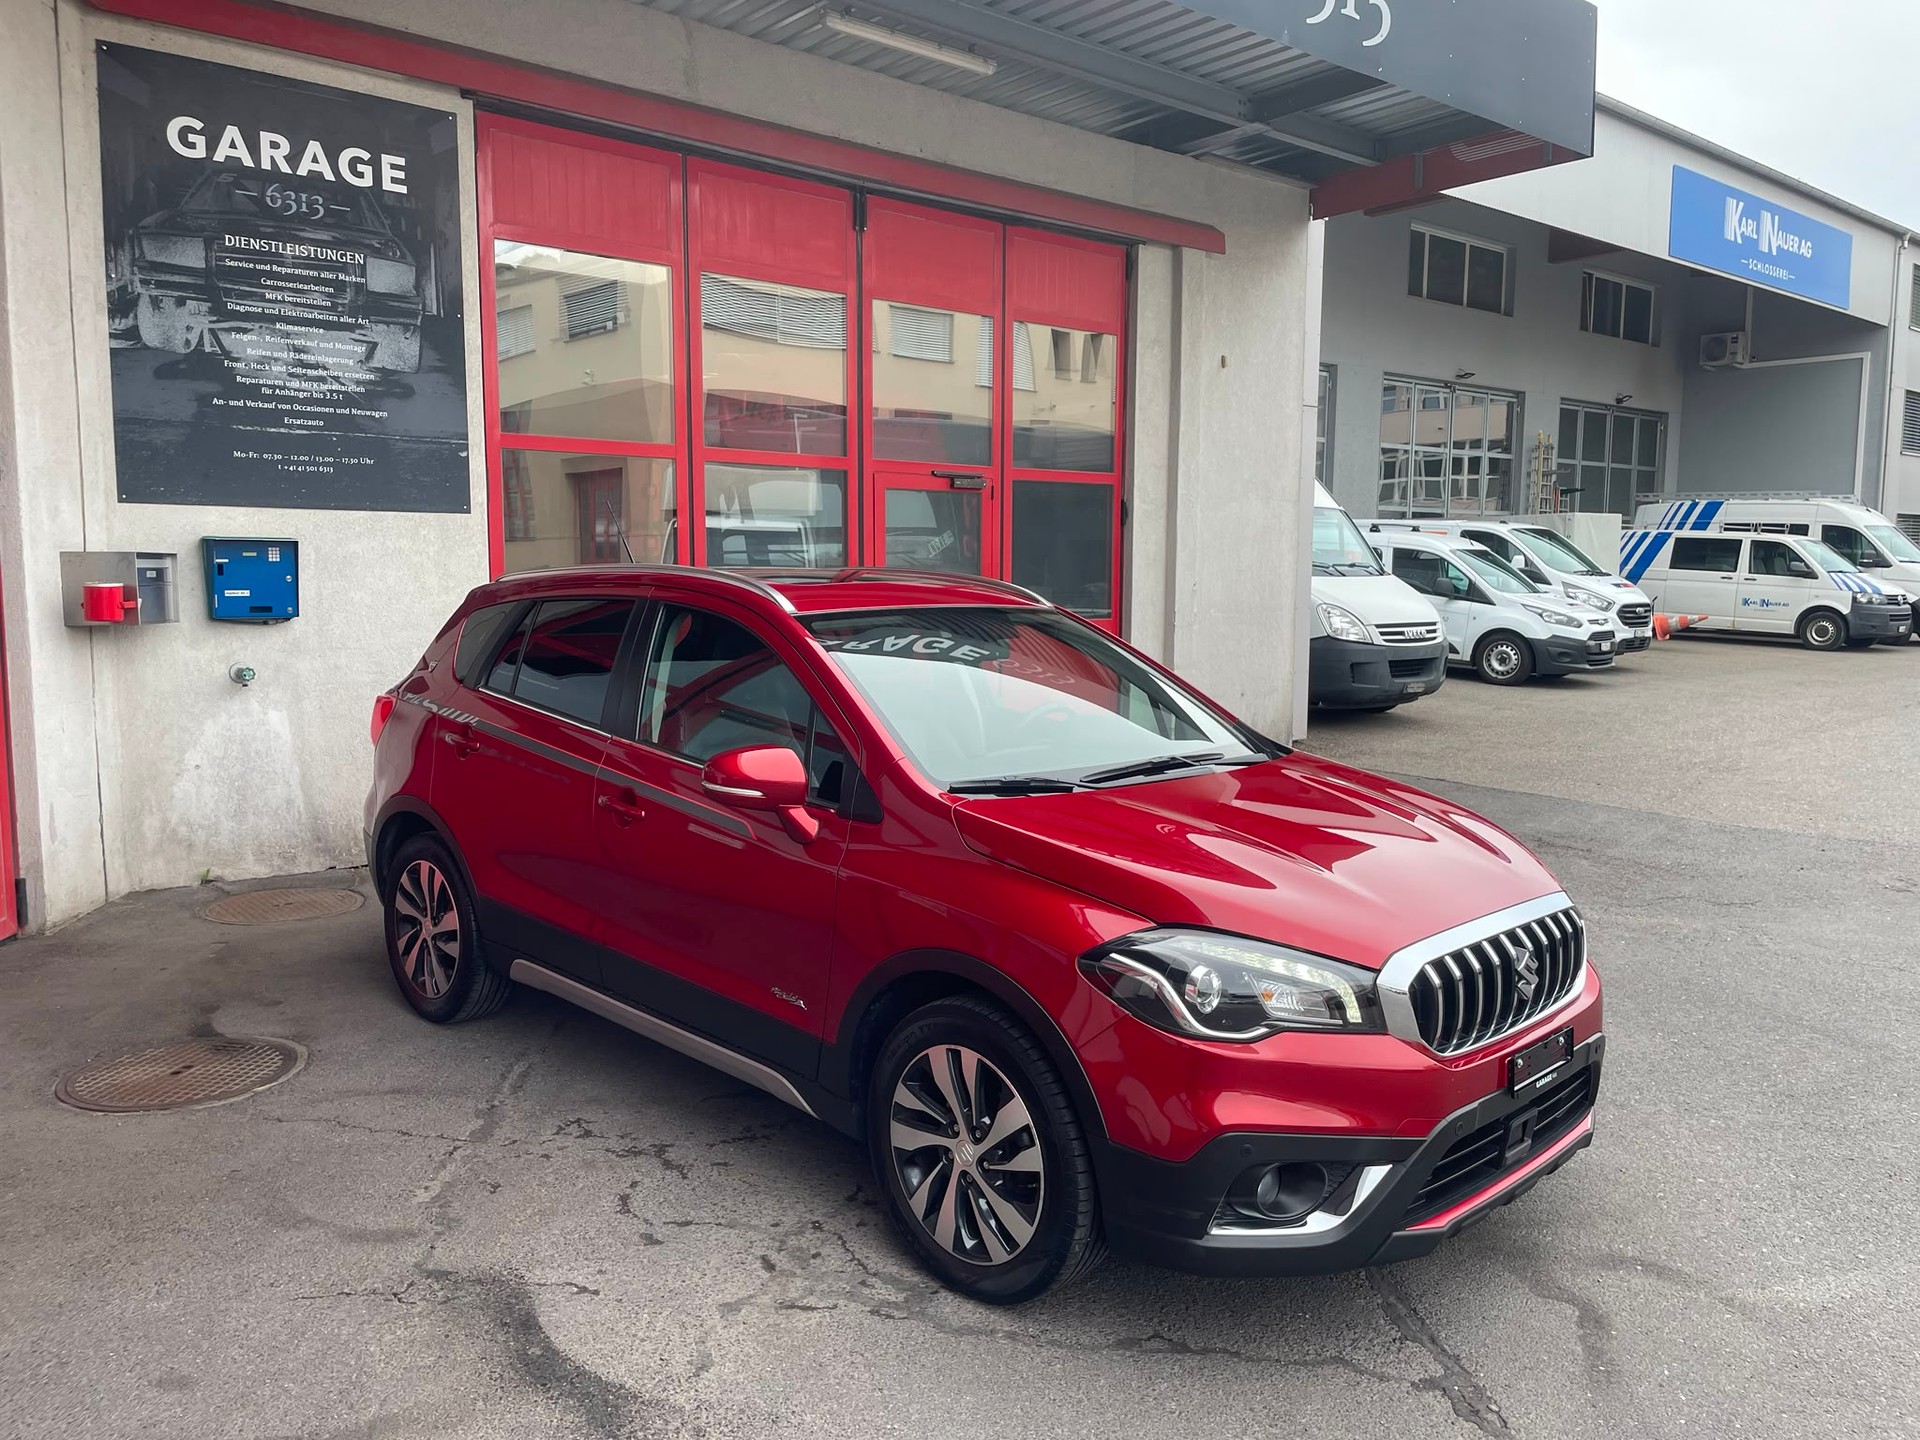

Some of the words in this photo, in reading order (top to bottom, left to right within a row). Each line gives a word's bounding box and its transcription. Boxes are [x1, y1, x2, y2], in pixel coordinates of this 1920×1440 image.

[166, 116, 407, 194] GARAGE
[265, 183, 325, 220] 6313
[1724, 196, 1758, 244] KARL
[1759, 209, 1800, 256] NAUER
[1799, 239, 1812, 259] AG
[225, 235, 364, 264] DIENSTLEISTUNGEN
[225, 259, 254, 269] Service
[256, 263, 270, 271] und
[272, 265, 318, 278] Reparaturen
[320, 271, 336, 280] aller
[338, 273, 365, 283] Marken
[1749, 258, 1789, 280] SCHLOSSEREI
[261, 278, 334, 293] Carrosseriearbeiten
[265, 292, 283, 301] MFK
[284, 294, 331, 307] bereitstellen
[227, 303, 262, 313] Diagnose
[264, 307, 278, 315] und
[281, 308, 338, 322] Elektroarbeiten
[340, 315, 355, 324] aller
[358, 317, 369, 325] Art
[276, 322, 324, 334] Klimaservice
[231, 332, 263, 342] Felgen-,
[265, 335, 318, 348] Reifenverkauf
[319, 341, 333, 349] und
[335, 342, 366, 352] Montage
[247, 348, 271, 357] Reifen
[289, 352, 354, 365] Rädereinlagerung
[224, 360, 248, 369] Front,
[250, 362, 270, 371] Heck
[272, 364, 286, 372] und
[288, 366, 343, 376] Seitenscheiben
[344, 371, 375, 380] ersetzen
[236, 375, 283, 387] Reparaturen
[285, 379, 300, 387] und
[301, 381, 319, 389] MFK
[320, 382, 365, 393] bereitstellen
[275, 389, 311, 399] Anhänger
[313, 390, 324, 399] bis
[325, 392, 338, 400] 3.5
[212, 397, 227, 405] An-
[229, 399, 244, 407] und
[245, 400, 276, 410] Verkauf
[293, 403, 335, 413] Occasionen
[336, 406, 350, 415] und
[351, 408, 388, 418] Neuwagen
[284, 416, 324, 426] Ersatzauto
[233, 450, 260, 459] Mo-Fr:
[263, 453, 282, 461] 07.30
[342, 457, 358, 465] 17.30
[360, 457, 374, 465] Uhr
[306, 465, 318, 473] 501
[319, 466, 333, 474] 6313
[1404, 628, 1427, 638] IVECO
